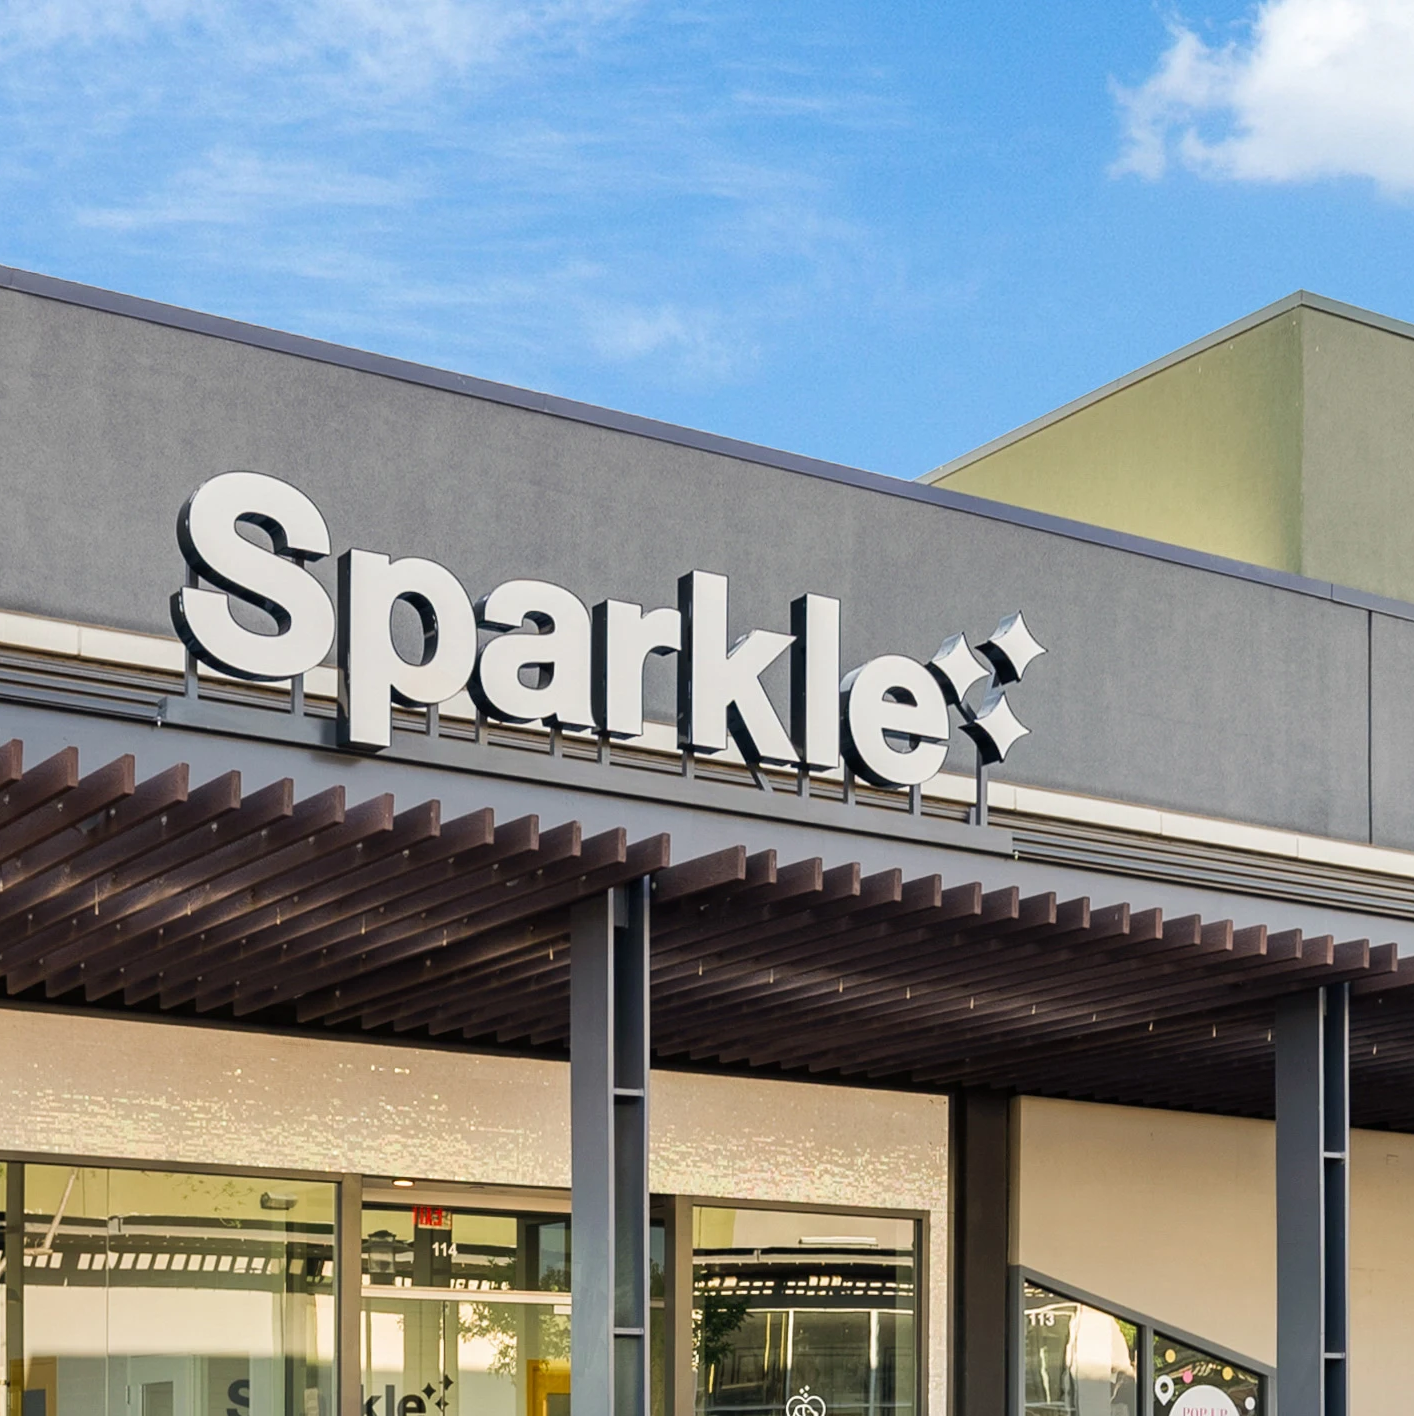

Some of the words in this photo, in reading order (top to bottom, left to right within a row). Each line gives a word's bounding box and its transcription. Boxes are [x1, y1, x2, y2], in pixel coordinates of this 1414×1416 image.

[171, 470, 950, 788] Sparkle
[432, 1242, 458, 1257] 114
[1029, 1312, 1055, 1326] 113
